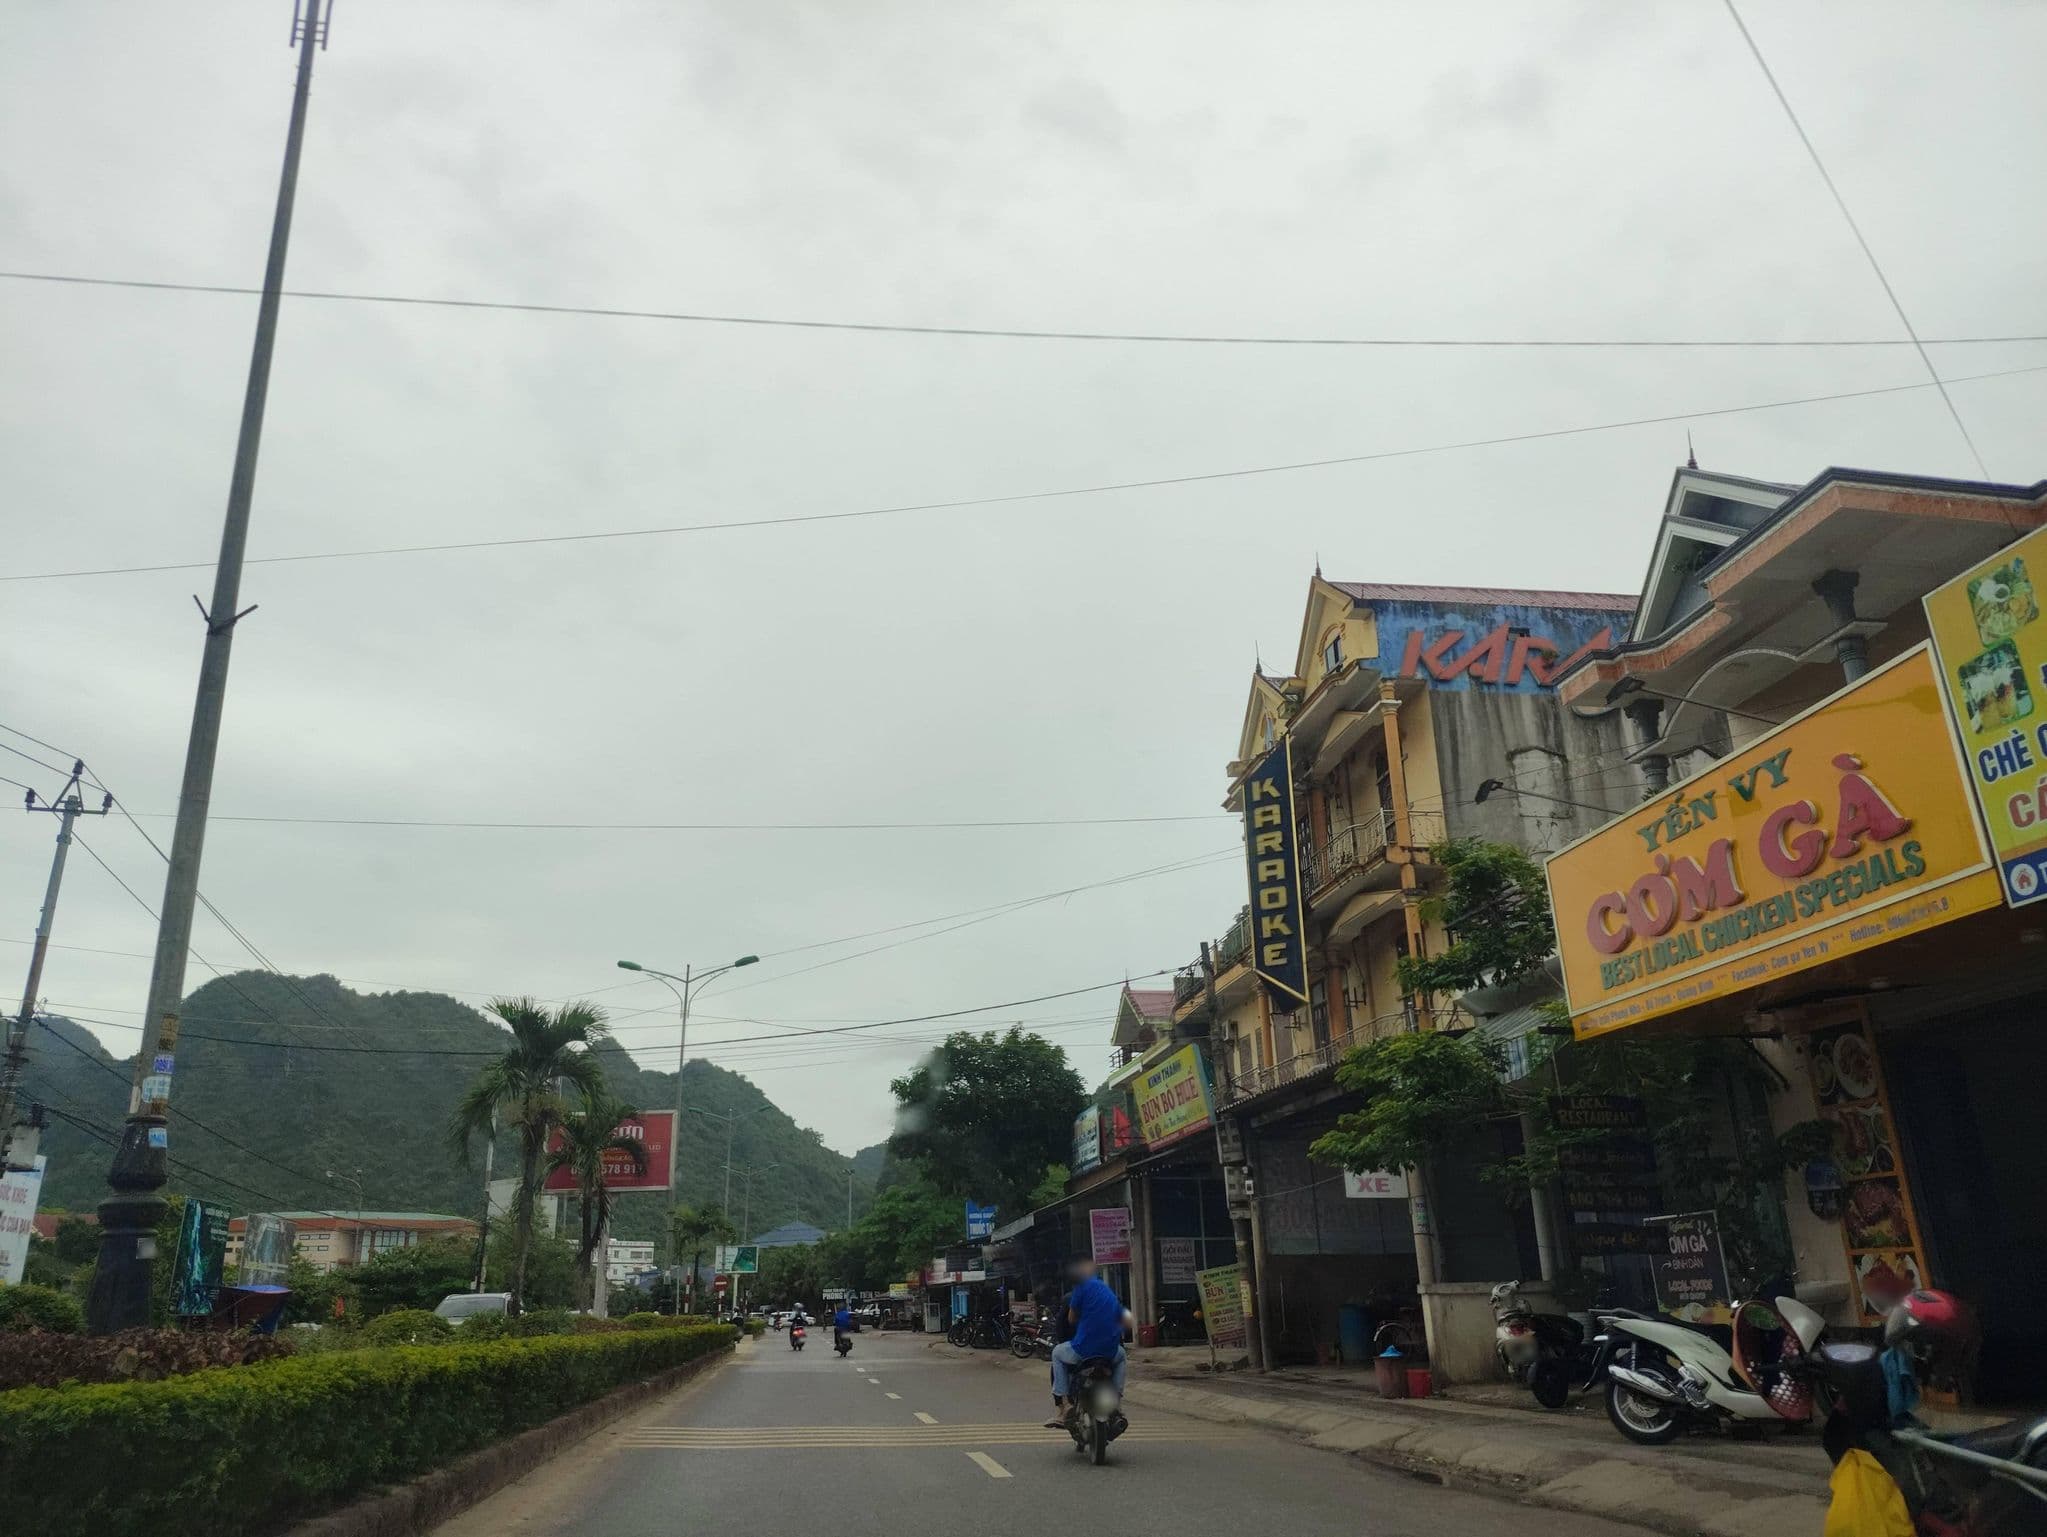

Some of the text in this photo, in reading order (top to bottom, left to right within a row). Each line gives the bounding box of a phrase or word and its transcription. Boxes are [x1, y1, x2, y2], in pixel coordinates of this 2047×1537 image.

[1978, 729, 2034, 783] CHÈ
[1637, 747, 1793, 853] YẾN VY
[1251, 776, 1294, 967] KARAOKE
[1586, 752, 1913, 954] CƠM GÀ
[1599, 950, 1643, 990] BEST
[1643, 929, 1704, 975] LOCAL
[1701, 890, 1798, 953] CHICKEN
[1795, 840, 1926, 918] SPECIALS
[1141, 1094, 1161, 1124] BÚN
[1175, 1065, 1199, 1106] HUẾ
[1356, 1178, 1390, 1193] XE
[1668, 1233, 1689, 1254] ƠM
